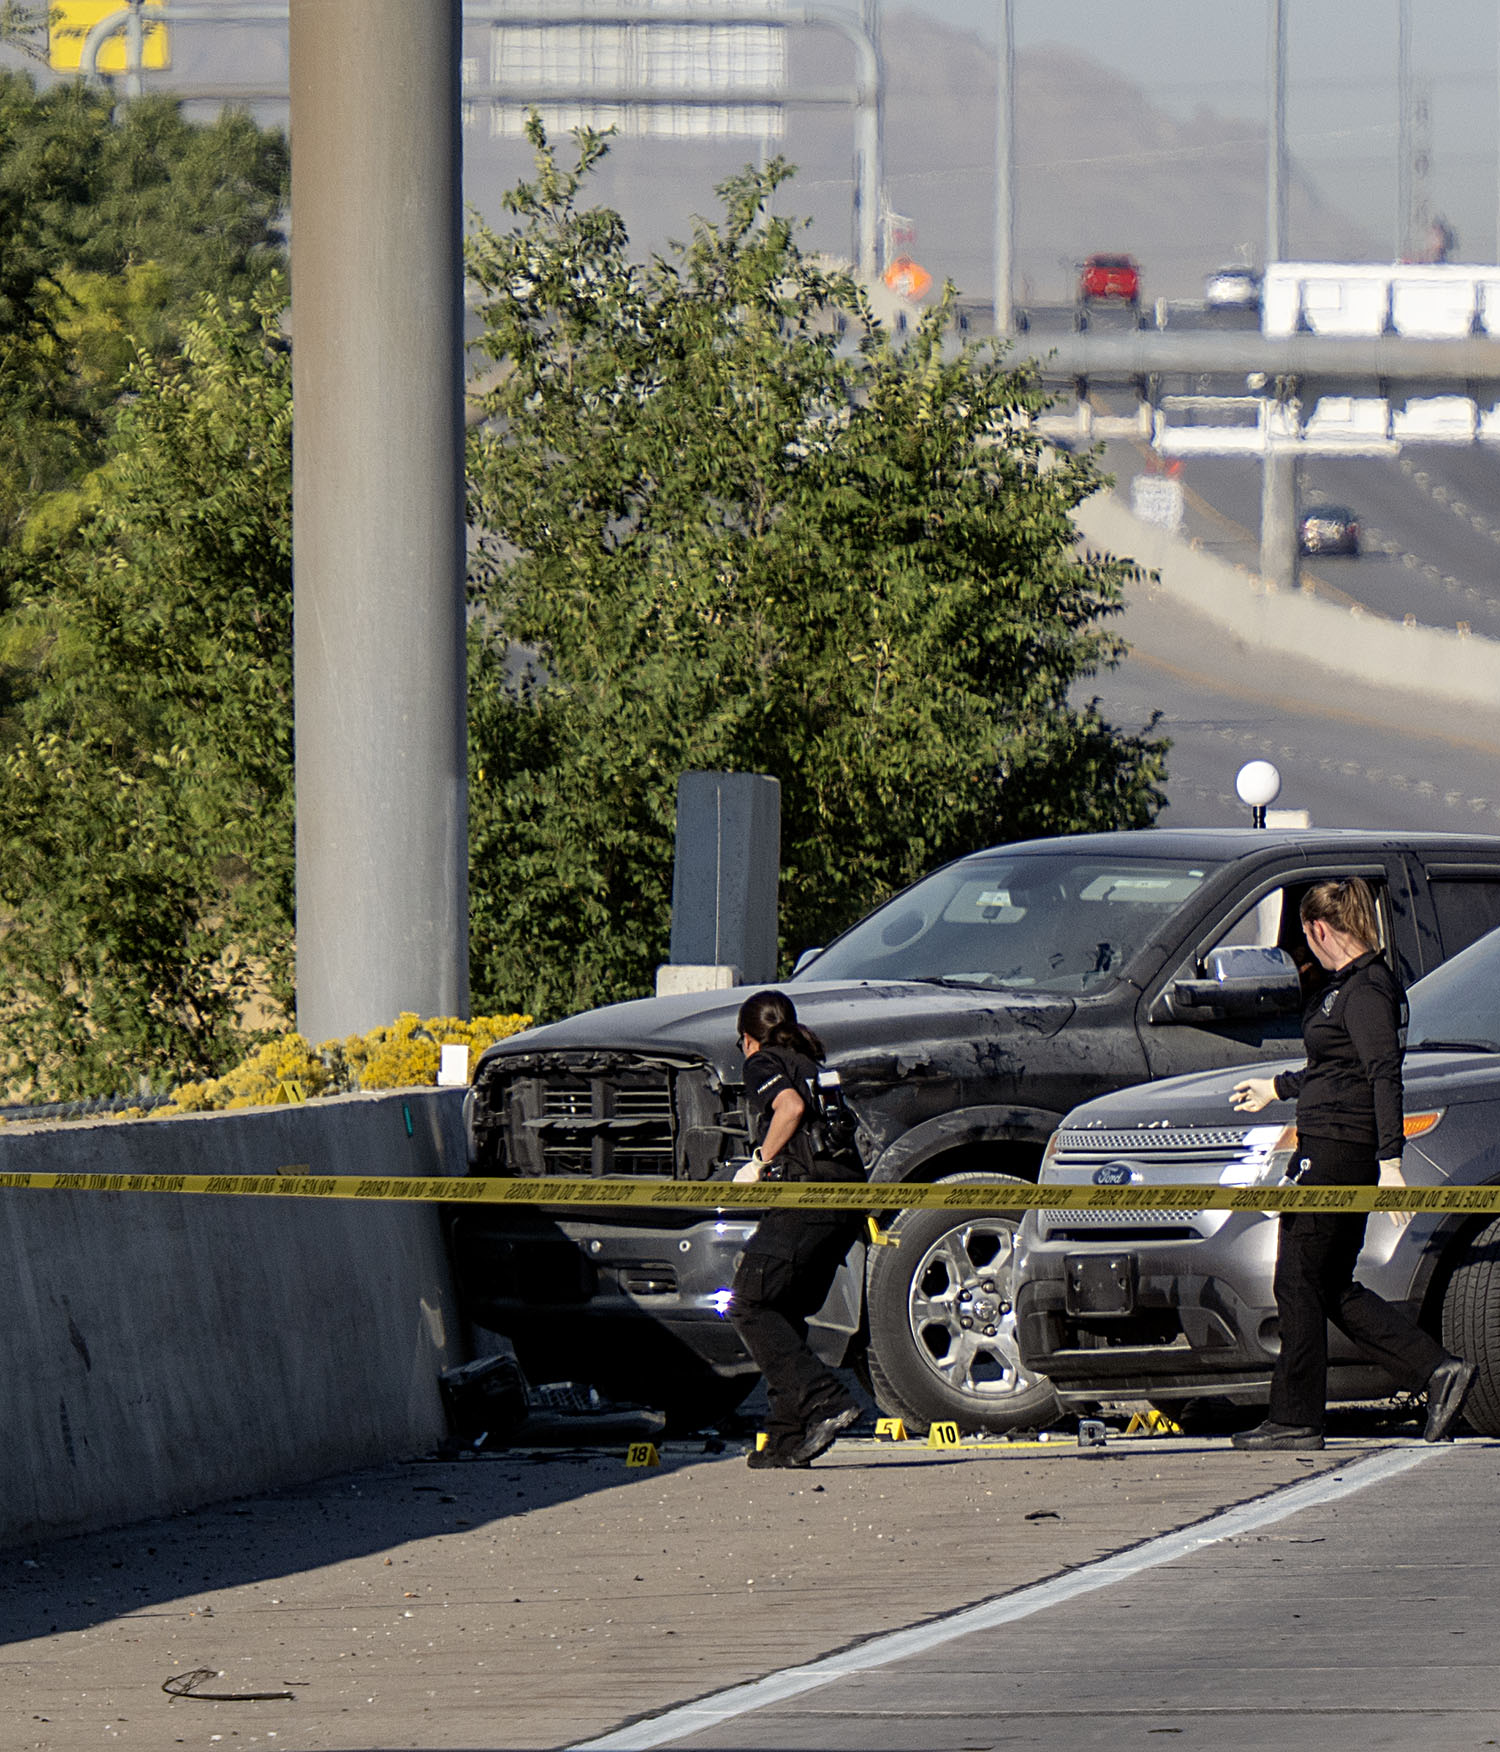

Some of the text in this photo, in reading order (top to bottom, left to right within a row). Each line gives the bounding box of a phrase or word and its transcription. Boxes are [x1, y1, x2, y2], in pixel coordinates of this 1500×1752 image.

[1097, 1167, 1124, 1184] Ford
[937, 1425, 957, 1444] 10
[631, 1446, 648, 1462] 18
